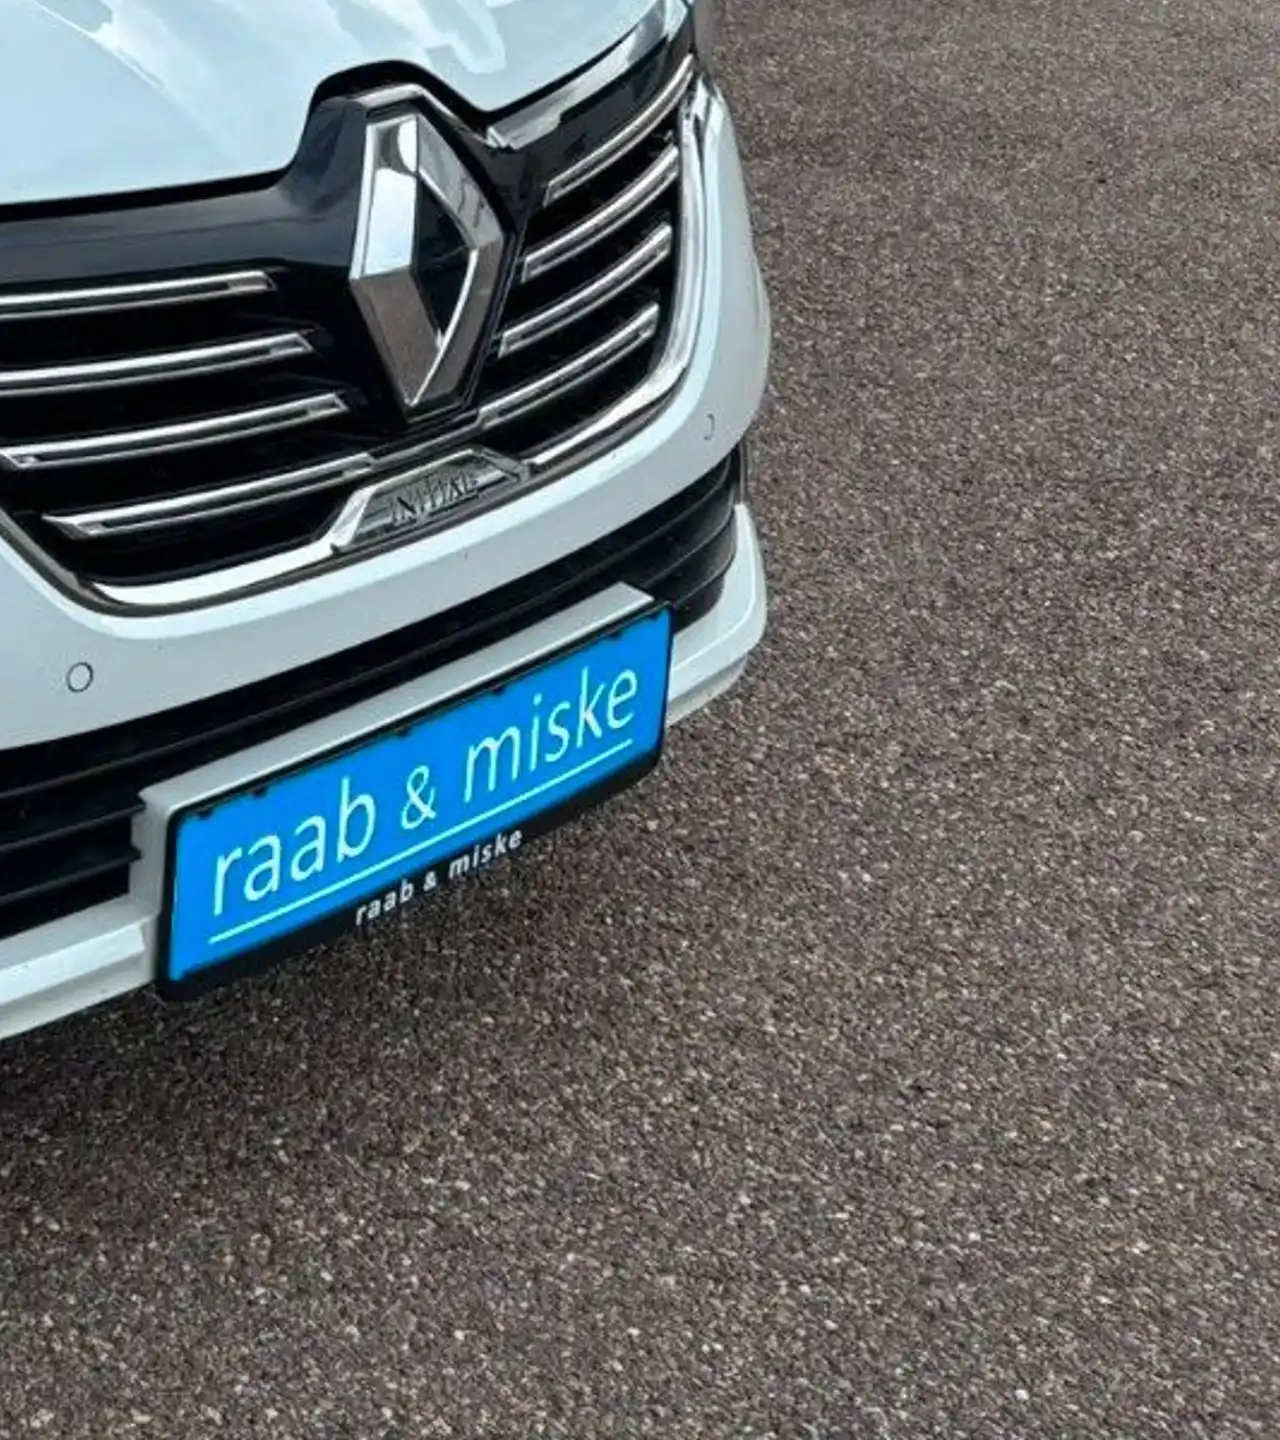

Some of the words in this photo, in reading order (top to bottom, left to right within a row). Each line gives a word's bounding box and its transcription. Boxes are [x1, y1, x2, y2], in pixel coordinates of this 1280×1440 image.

[212, 776, 377, 917] raab
[400, 764, 438, 831] &
[463, 666, 639, 804] miske
[355, 873, 414, 927] raab
[423, 872, 438, 893] &
[448, 827, 523, 881] miske
